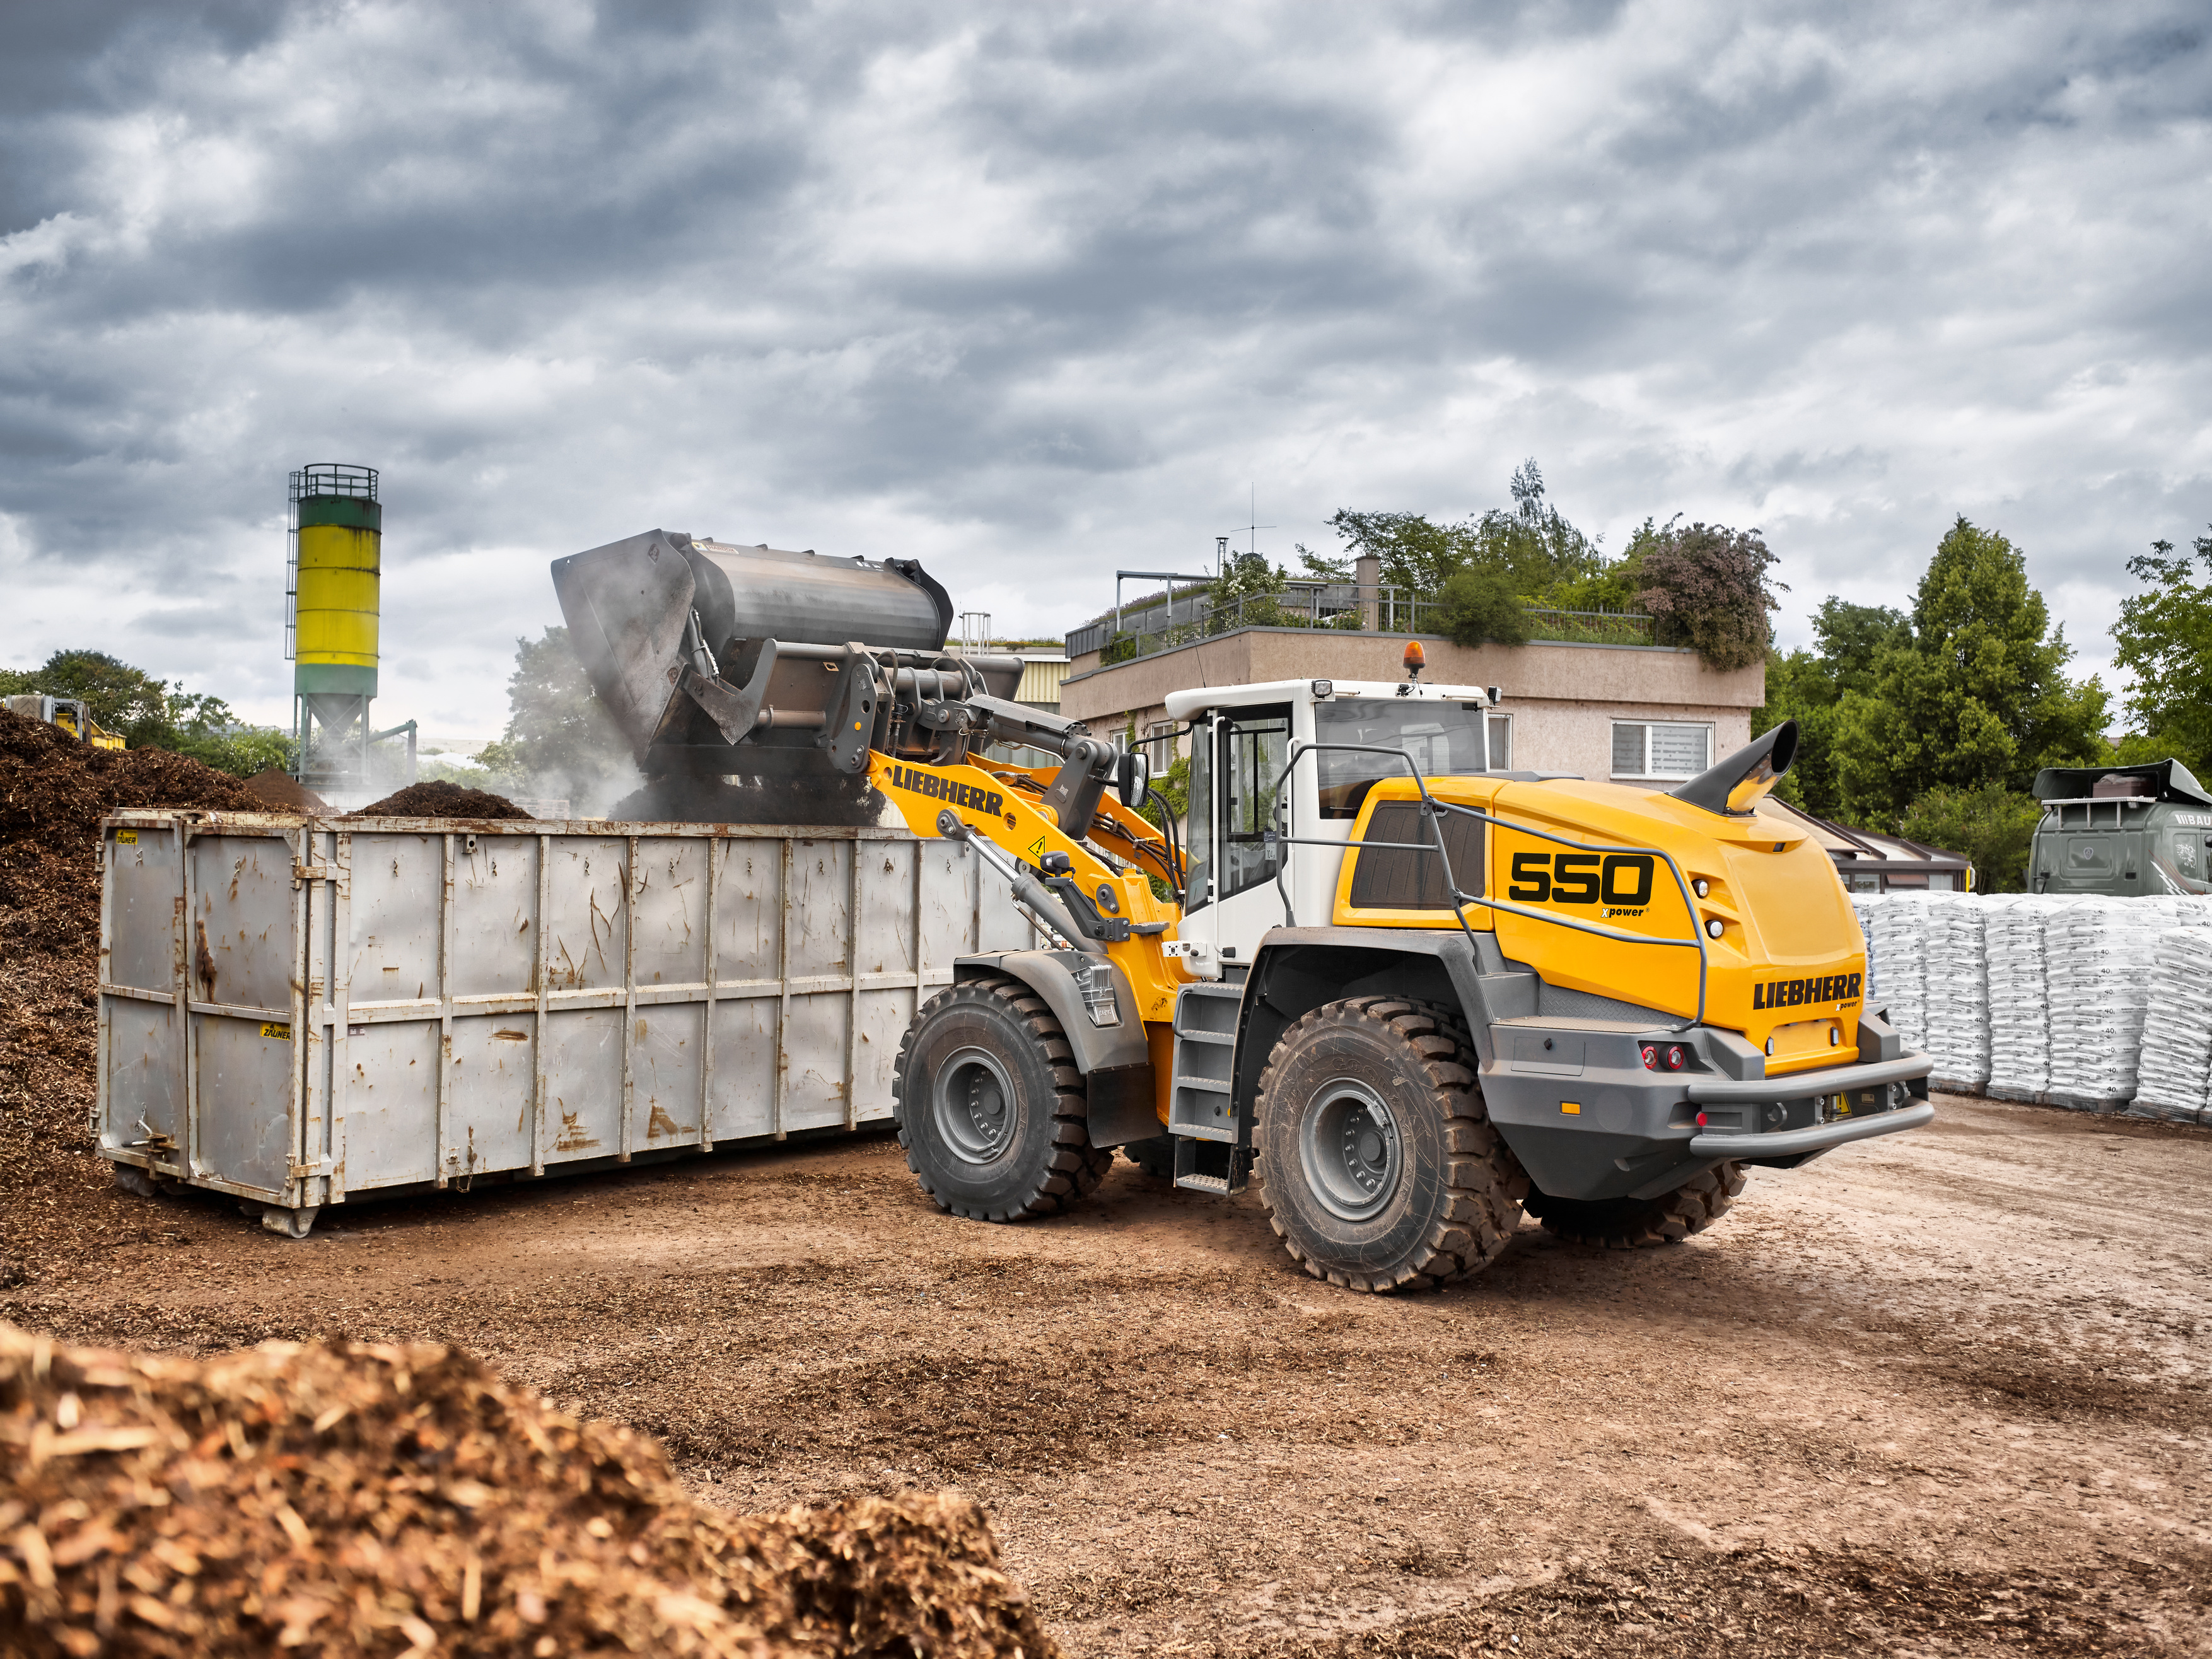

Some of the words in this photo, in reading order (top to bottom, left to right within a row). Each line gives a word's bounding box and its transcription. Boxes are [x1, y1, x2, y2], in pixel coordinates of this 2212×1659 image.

[892, 765, 1003, 817] LIEBHERR
[1508, 852, 1655, 906] 550
[1753, 972, 1861, 1010] LIEBHERR
[264, 1028, 291, 1040] ZAUNER
